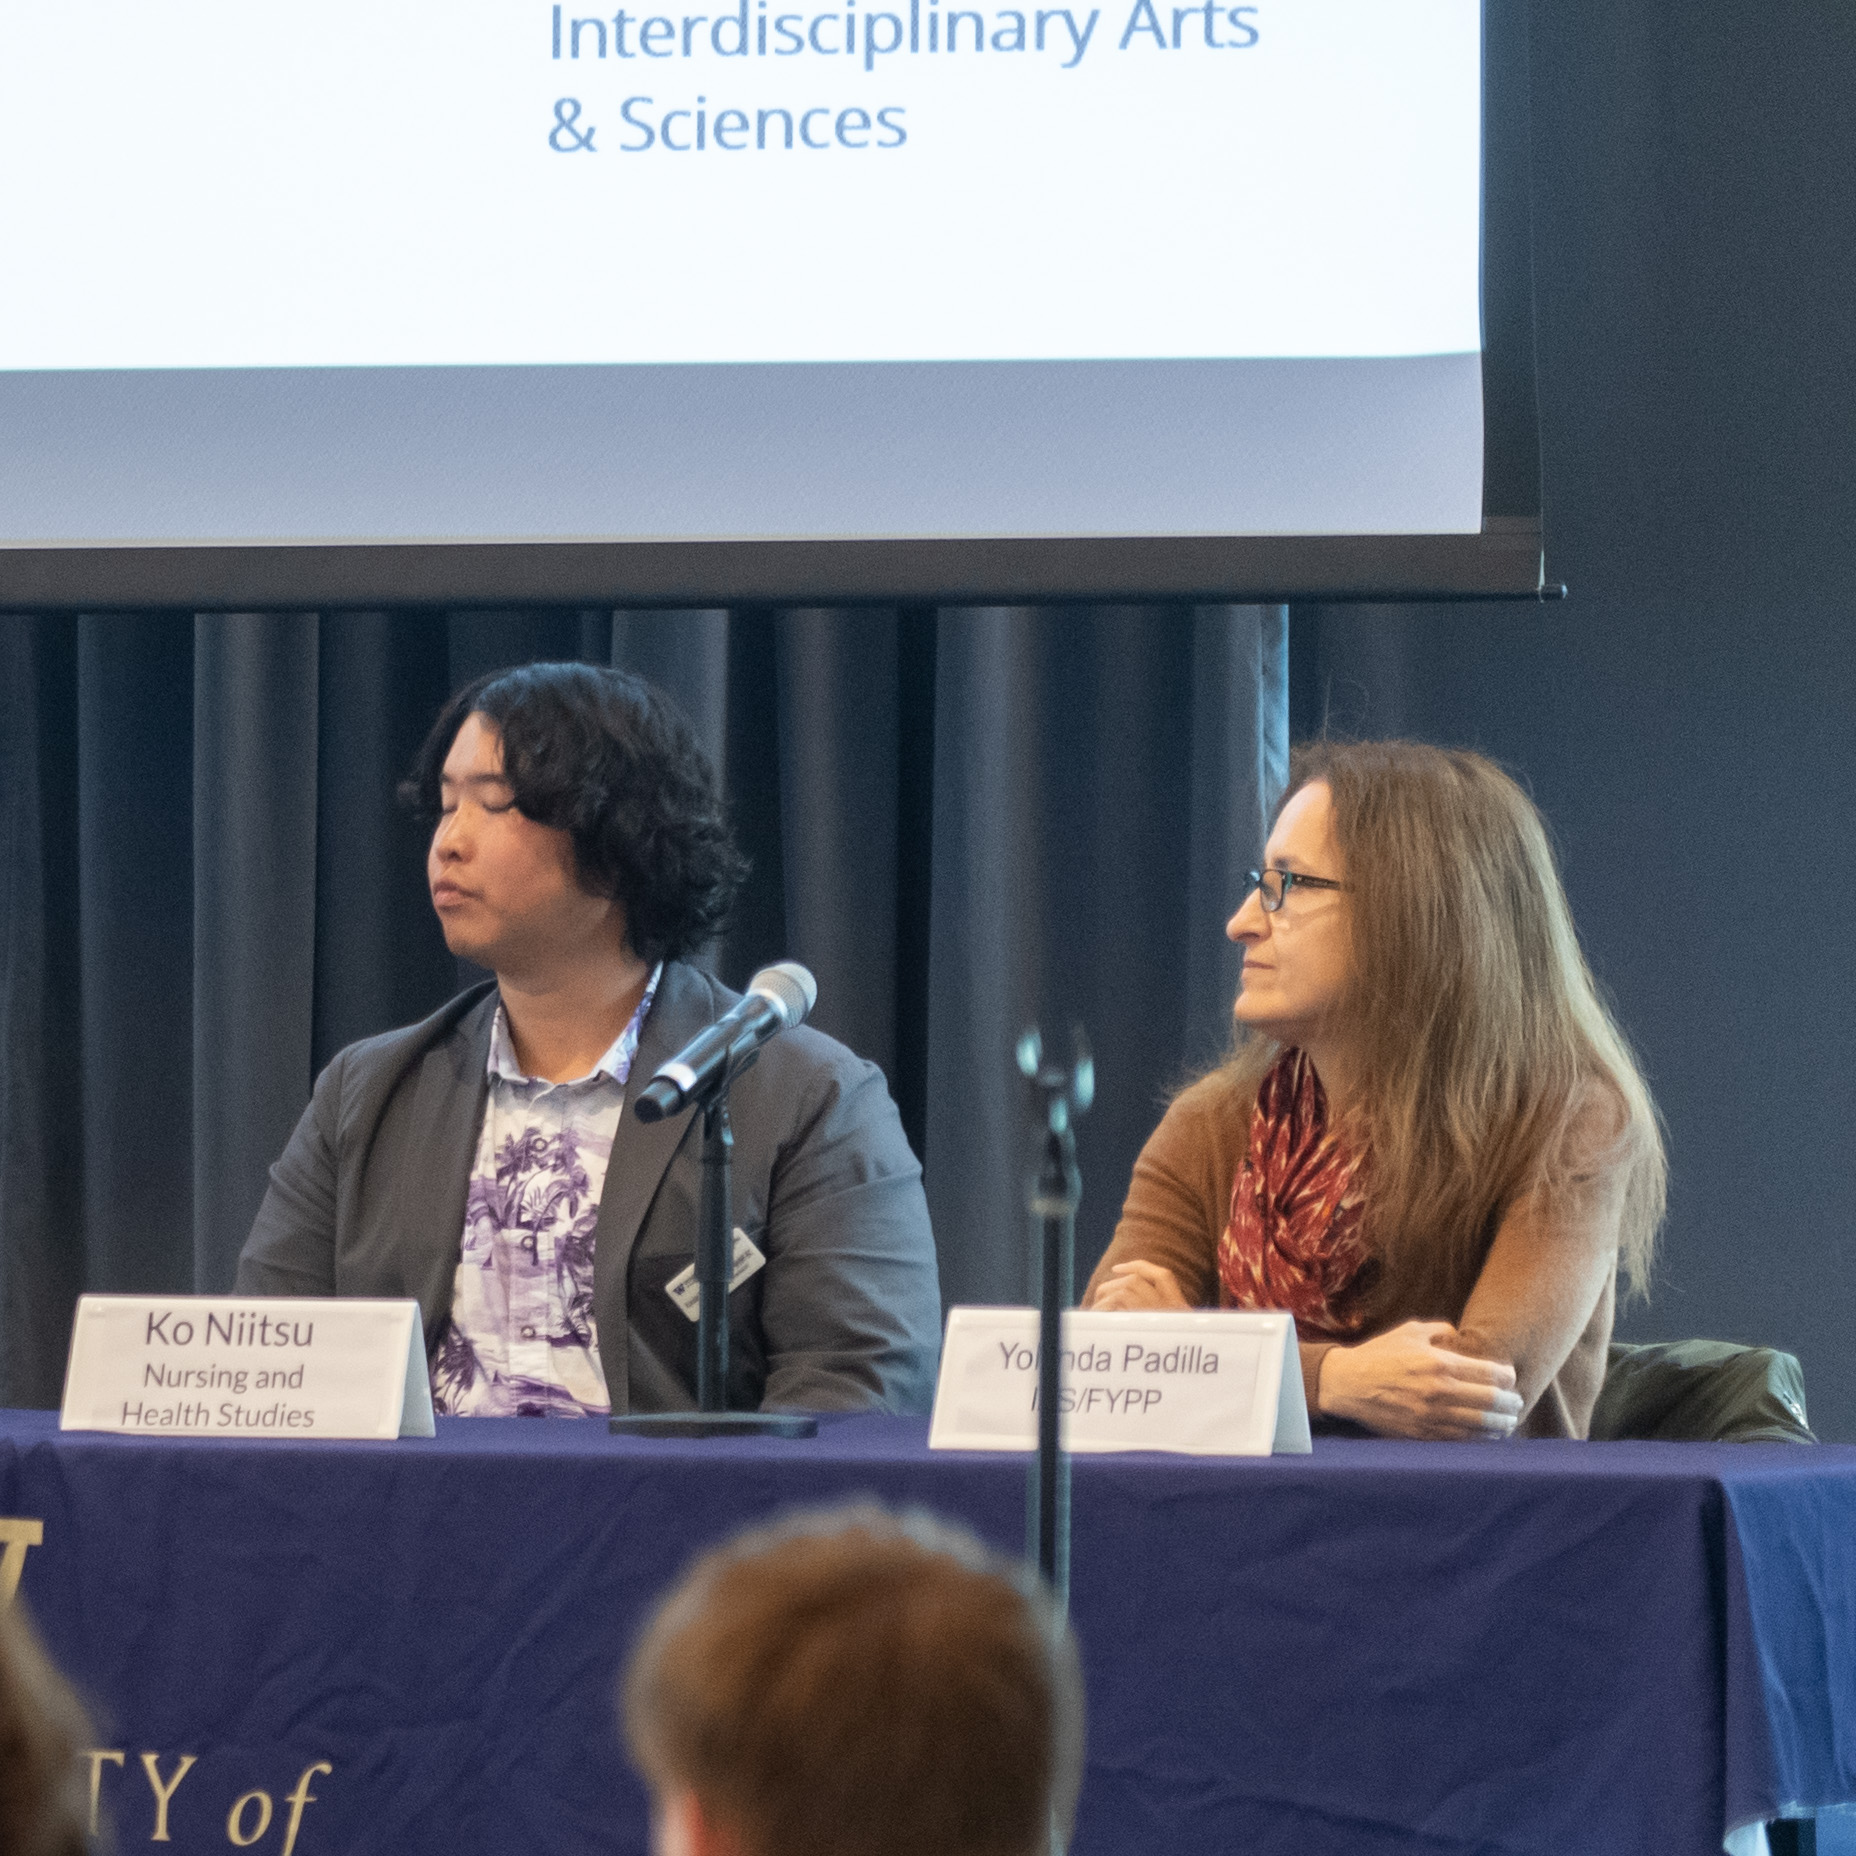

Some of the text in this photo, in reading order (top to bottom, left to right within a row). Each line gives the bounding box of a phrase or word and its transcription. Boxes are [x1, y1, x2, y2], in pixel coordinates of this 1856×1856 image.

[551, 0, 1261, 71] Interdisciplinary Arts
[547, 94, 909, 153] & Sciences
[145, 1311, 314, 1347] Ko Niitsu
[999, 1341, 1219, 1375] Yolnda Padilla
[143, 1363, 305, 1394] Nursing and
[121, 1401, 315, 1429] Health Studies
[1031, 1386, 1163, 1415] IS/FYPP
